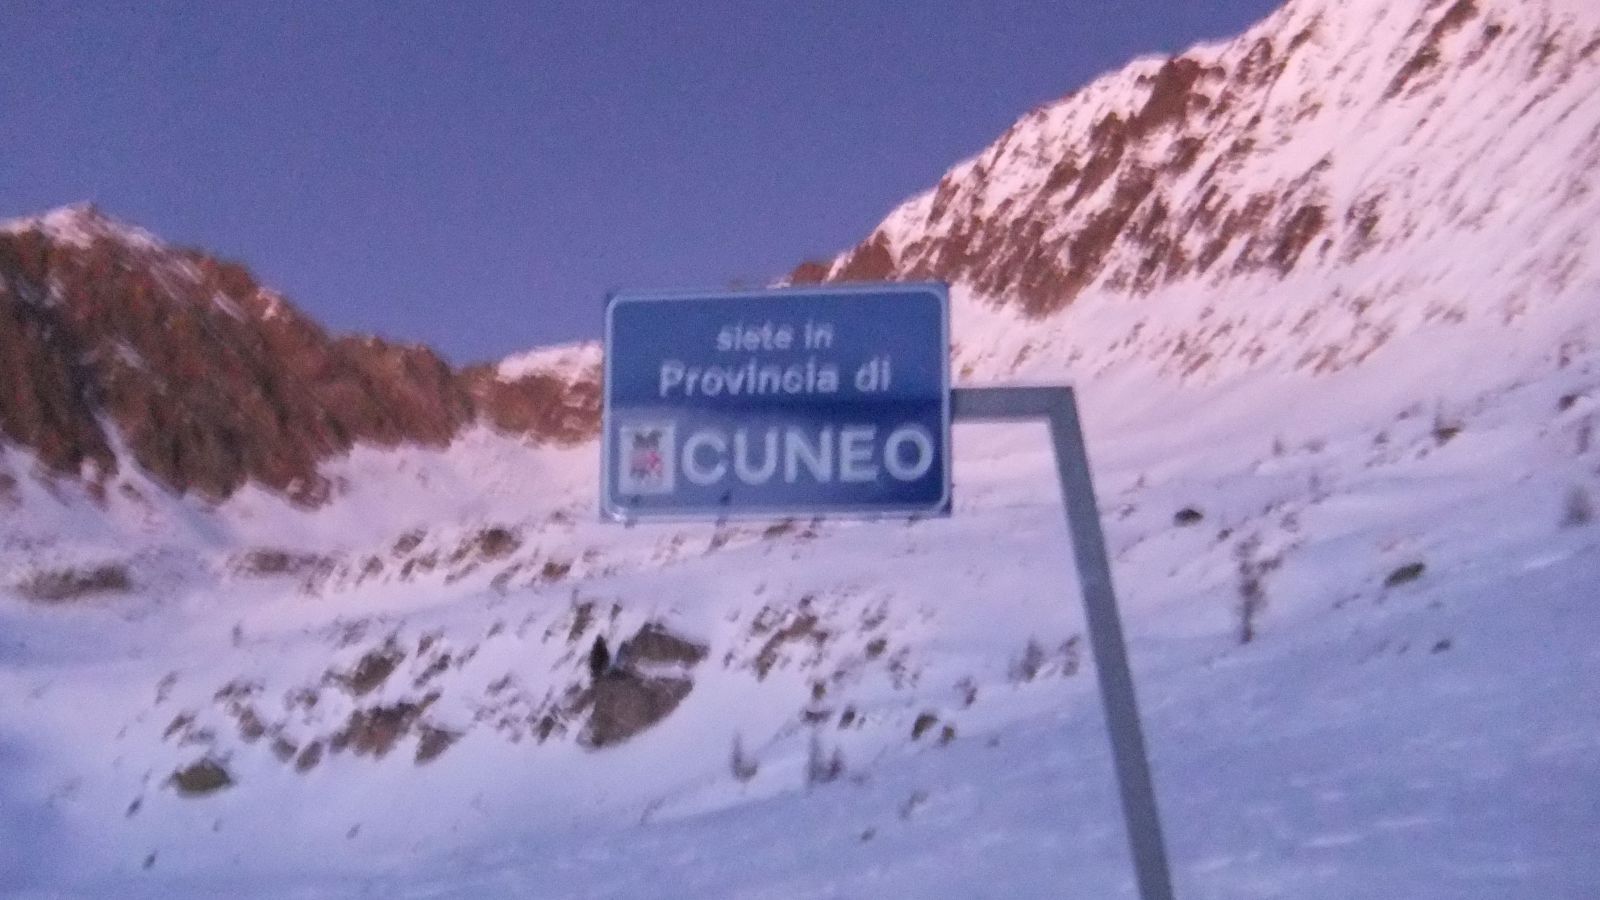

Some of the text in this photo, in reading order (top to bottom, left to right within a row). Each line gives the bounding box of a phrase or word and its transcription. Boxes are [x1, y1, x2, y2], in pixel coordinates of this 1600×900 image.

[717, 320, 834, 350] siete in
[659, 355, 892, 397] Provincia di
[681, 424, 934, 485] CUNEO
